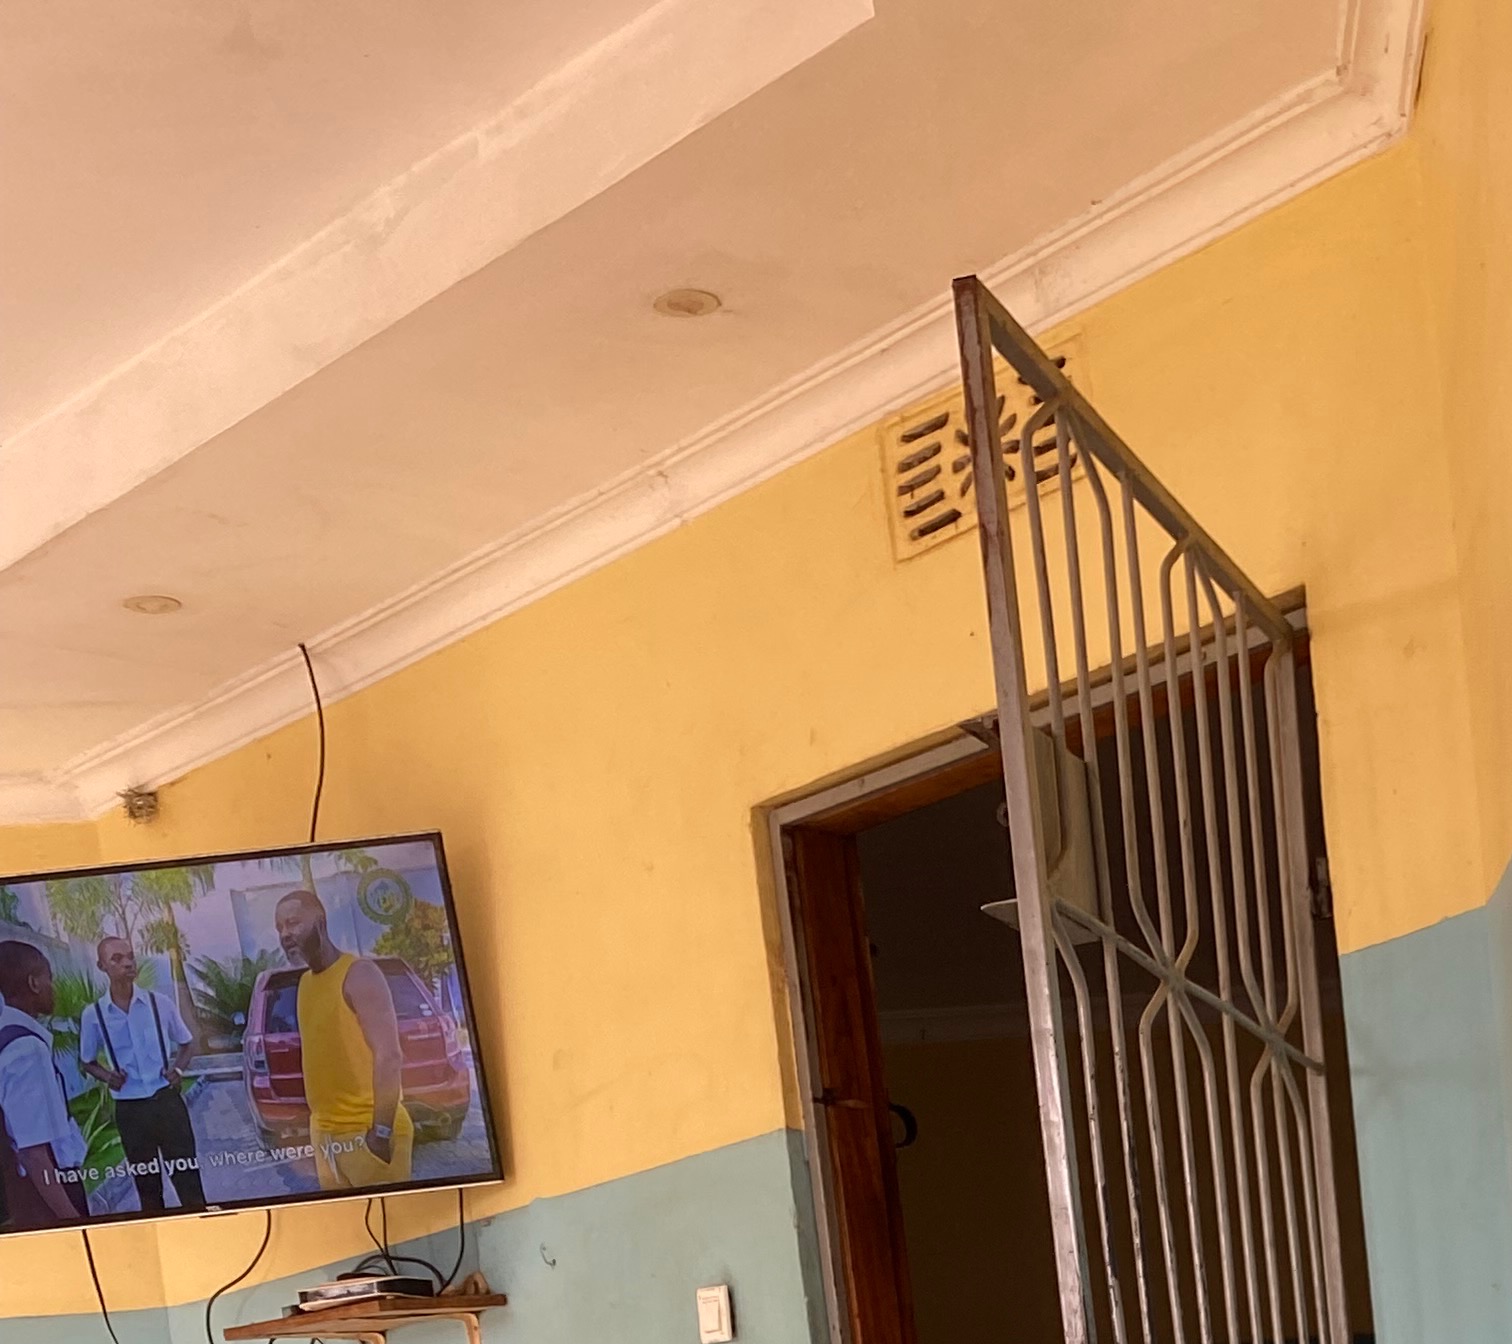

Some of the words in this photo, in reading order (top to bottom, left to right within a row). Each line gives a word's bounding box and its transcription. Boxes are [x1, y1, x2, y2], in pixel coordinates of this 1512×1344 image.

[43, 1169, 50, 1185] I
[55, 1166, 99, 1184] have
[105, 1157, 160, 1179] asked
[209, 1149, 265, 1167] where
[270, 1144, 315, 1161] were
[320, 1135, 365, 1159] you?
